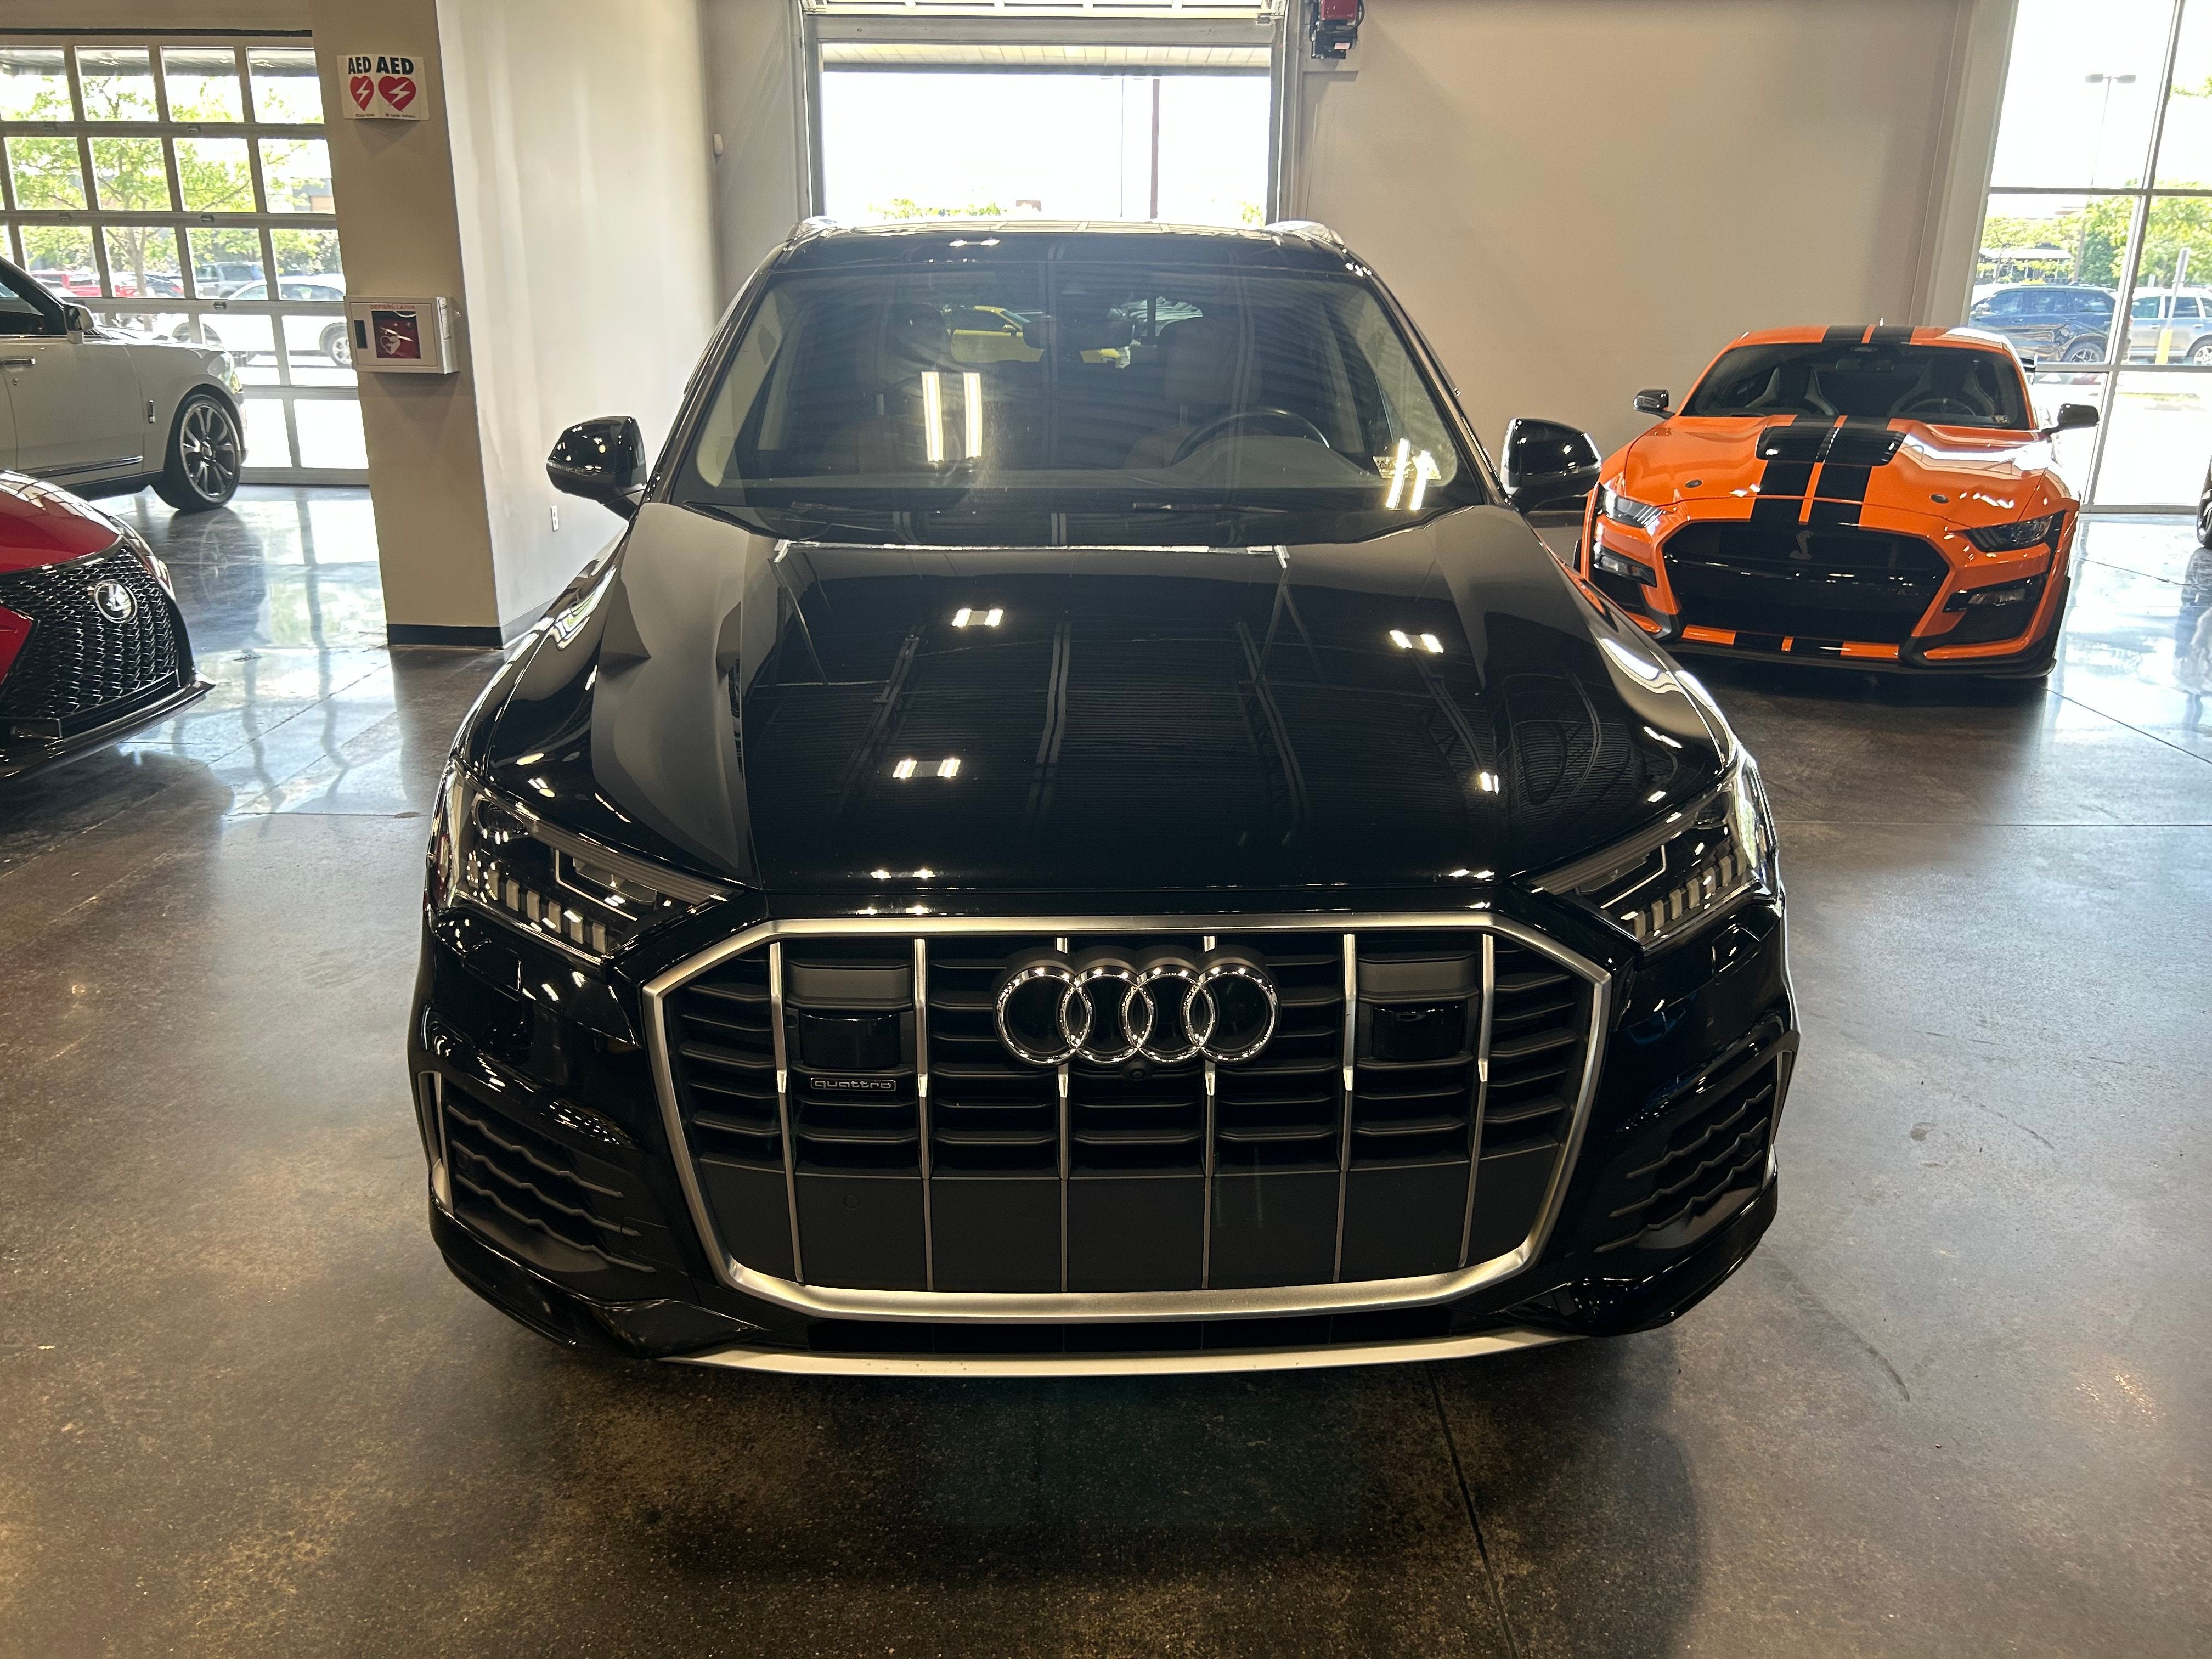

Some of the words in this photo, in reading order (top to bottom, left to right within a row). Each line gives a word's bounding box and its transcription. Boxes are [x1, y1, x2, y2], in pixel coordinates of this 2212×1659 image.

[348, 56, 371, 74] AED
[376, 56, 414, 75] AED
[815, 1080, 891, 1088] quattro
